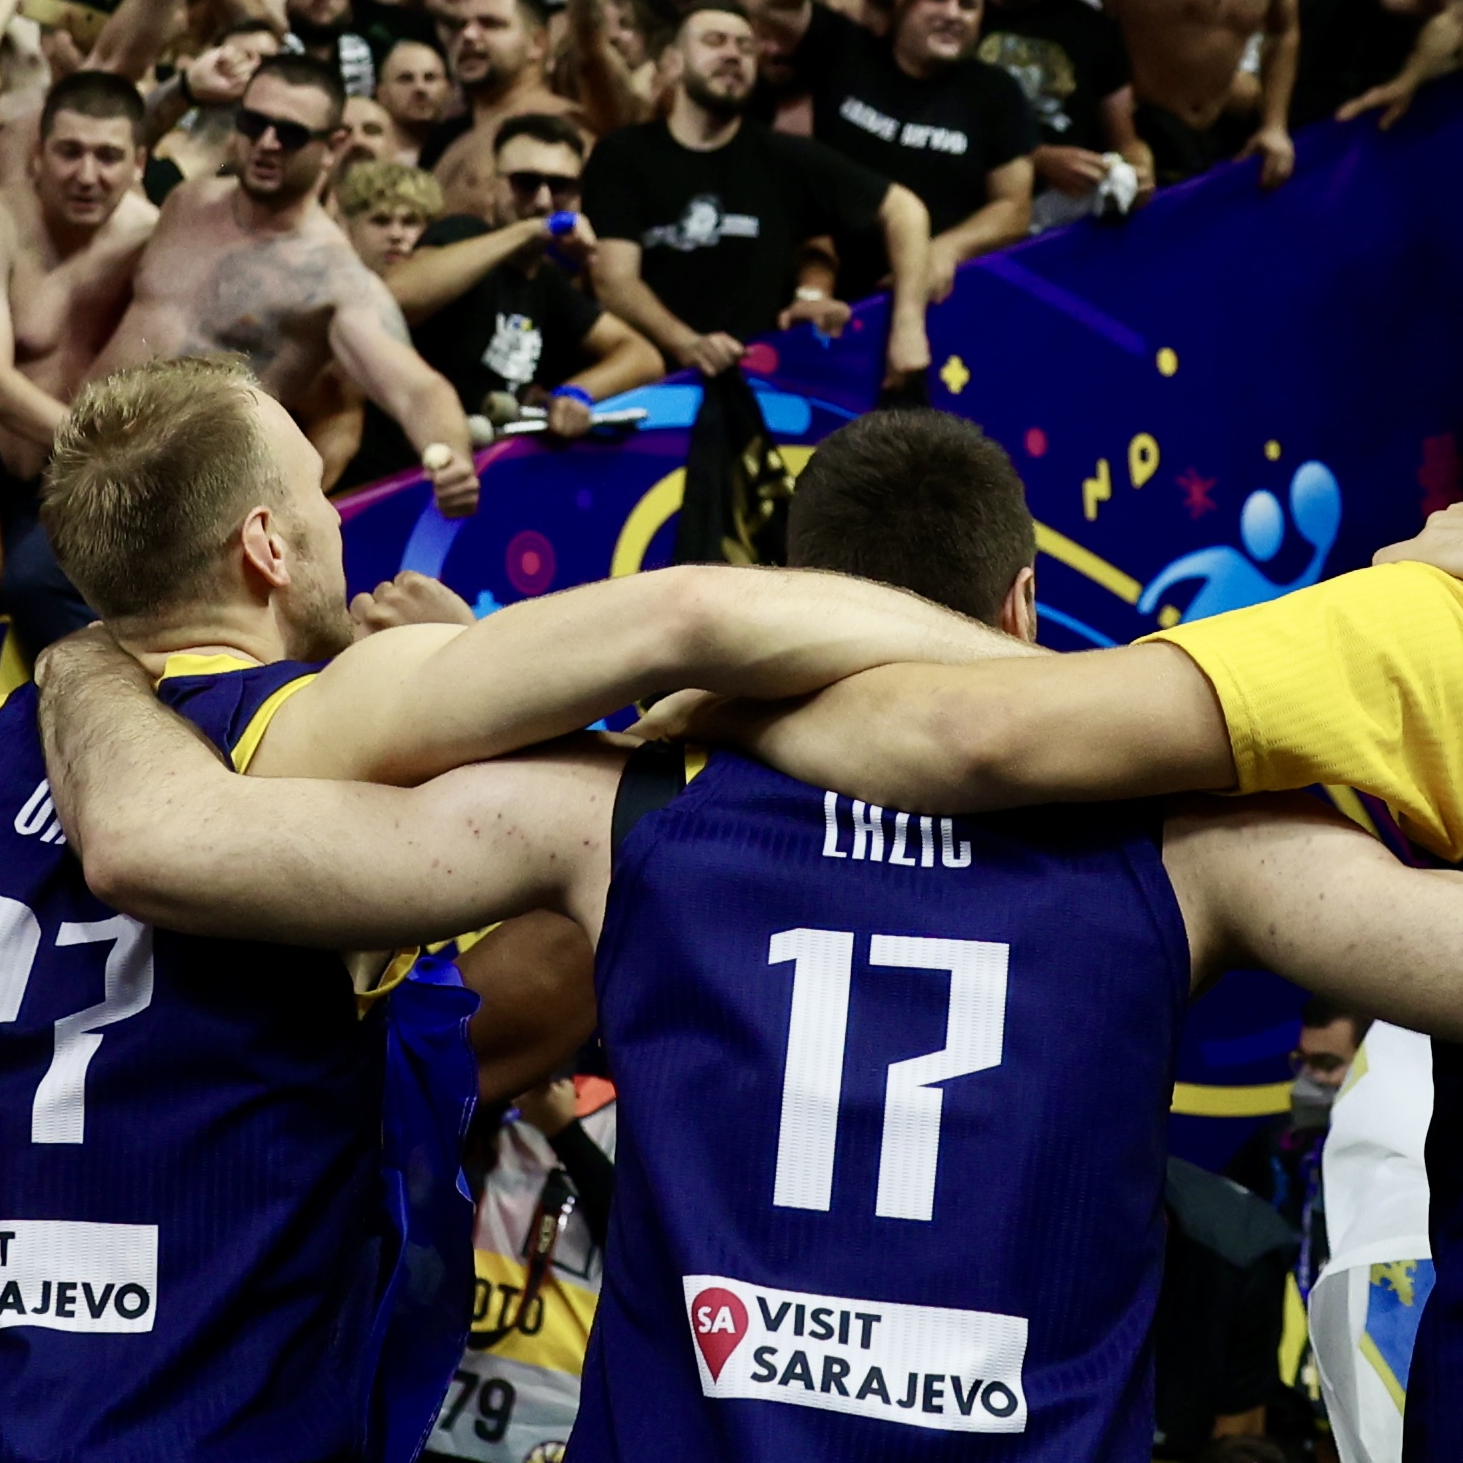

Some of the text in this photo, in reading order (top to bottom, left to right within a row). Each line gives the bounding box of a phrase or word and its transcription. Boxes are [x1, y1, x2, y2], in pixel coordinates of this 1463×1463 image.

[767, 927, 1011, 1222] 17
[697, 1305, 737, 1335] SA
[756, 1295, 882, 1351] VISIT
[750, 1346, 1019, 1418] SARAJEVO
